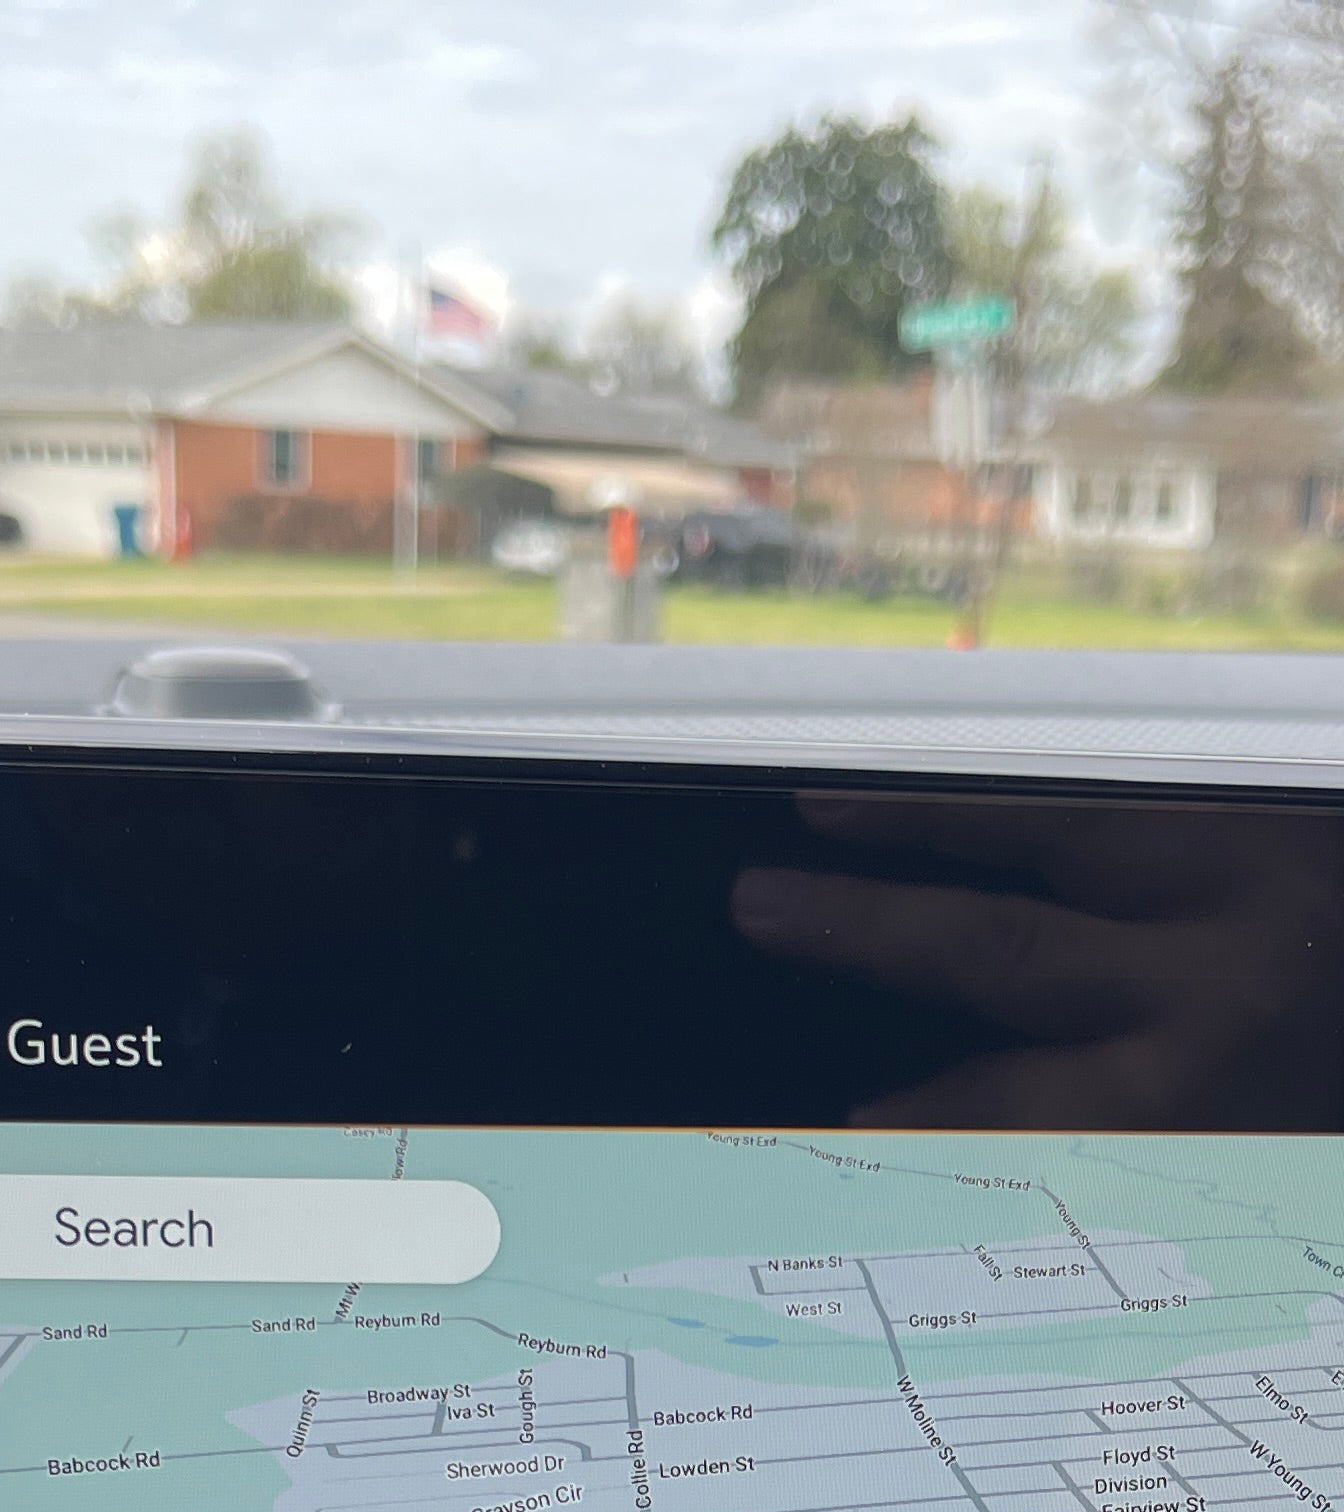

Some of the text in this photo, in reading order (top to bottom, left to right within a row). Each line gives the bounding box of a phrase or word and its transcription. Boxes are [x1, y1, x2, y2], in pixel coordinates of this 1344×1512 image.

[7, 1018, 163, 1067] Guest
[55, 1207, 215, 1248] Search
[783, 1258, 824, 1272] Banks
[829, 1256, 843, 1269] St
[1013, 1264, 1086, 1279] Stewart St
[786, 1302, 842, 1316] West St
[1120, 1295, 1188, 1312] Griggs St
[251, 1317, 316, 1333] Sand Rd
[909, 1311, 977, 1329] Griggs St
[42, 1325, 107, 1340] Sand Rd
[1331, 1370, 1344, 1385] E
[368, 1384, 471, 1403] Broadway St
[1255, 1375, 1309, 1425] Elmo St
[447, 1403, 495, 1420] Iva St
[519, 1368, 537, 1444] Gough St
[654, 1405, 753, 1427] Babcock Rd
[1101, 1395, 1186, 1416] Hoover St
[287, 1389, 320, 1458] Quinn St
[897, 1375, 956, 1467] W Moline St
[47, 1452, 160, 1477] Babcock Rd
[1103, 1445, 1176, 1467] Floyd St
[447, 1455, 566, 1479] Sherwood Dr
[627, 1430, 652, 1509] Collie Rd
[660, 1458, 756, 1479] Lowden St
[1250, 1440, 1270, 1459] W
[1267, 1453, 1312, 1501] Young
[1095, 1475, 1167, 1494] Division
[556, 1484, 583, 1507] Cir
